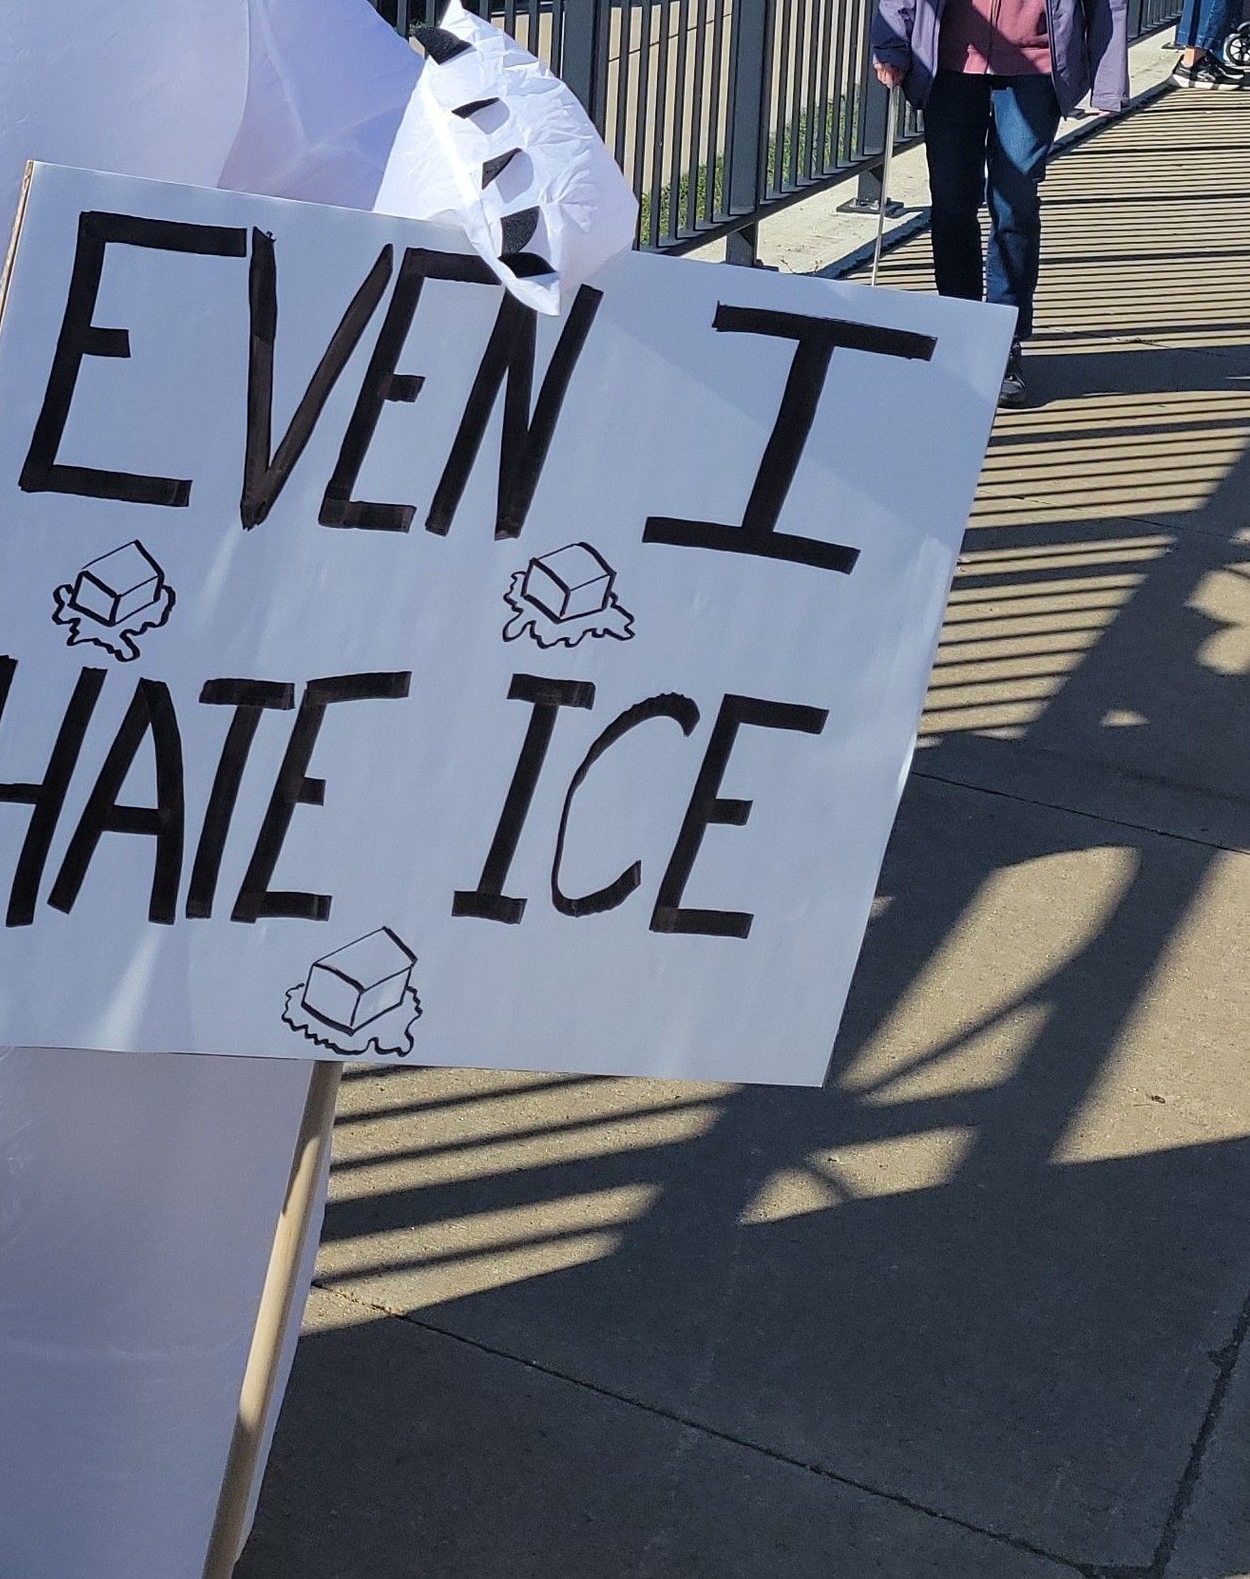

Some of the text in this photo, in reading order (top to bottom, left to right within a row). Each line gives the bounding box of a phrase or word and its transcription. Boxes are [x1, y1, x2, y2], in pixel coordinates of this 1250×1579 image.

[18, 211, 938, 575] EVEN I
[451, 673, 830, 939] ICE
